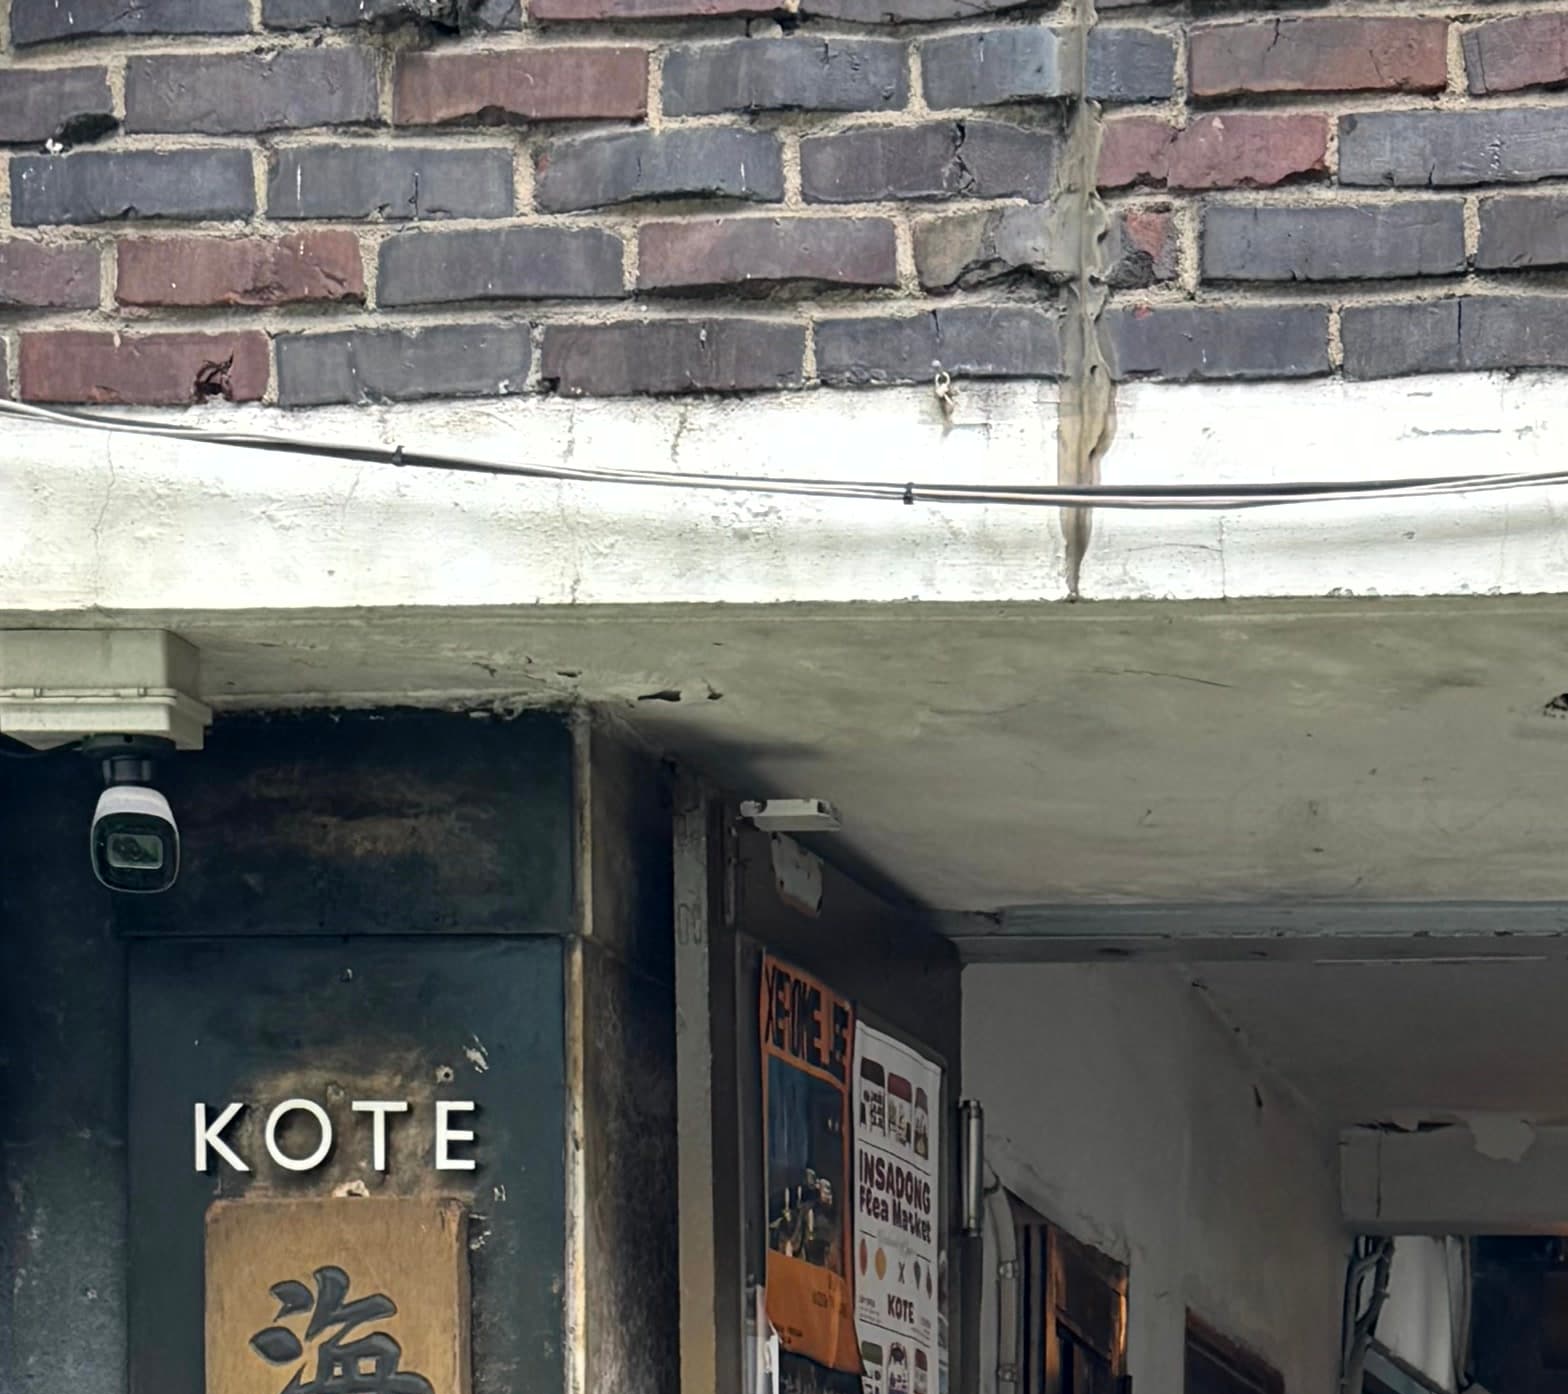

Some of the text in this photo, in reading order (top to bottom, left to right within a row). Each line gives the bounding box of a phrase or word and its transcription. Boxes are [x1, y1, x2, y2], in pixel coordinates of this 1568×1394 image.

[194, 1098, 477, 1172] KOTE
[858, 1148, 931, 1215] INSADONG
[887, 1293, 915, 1324] KOTE
